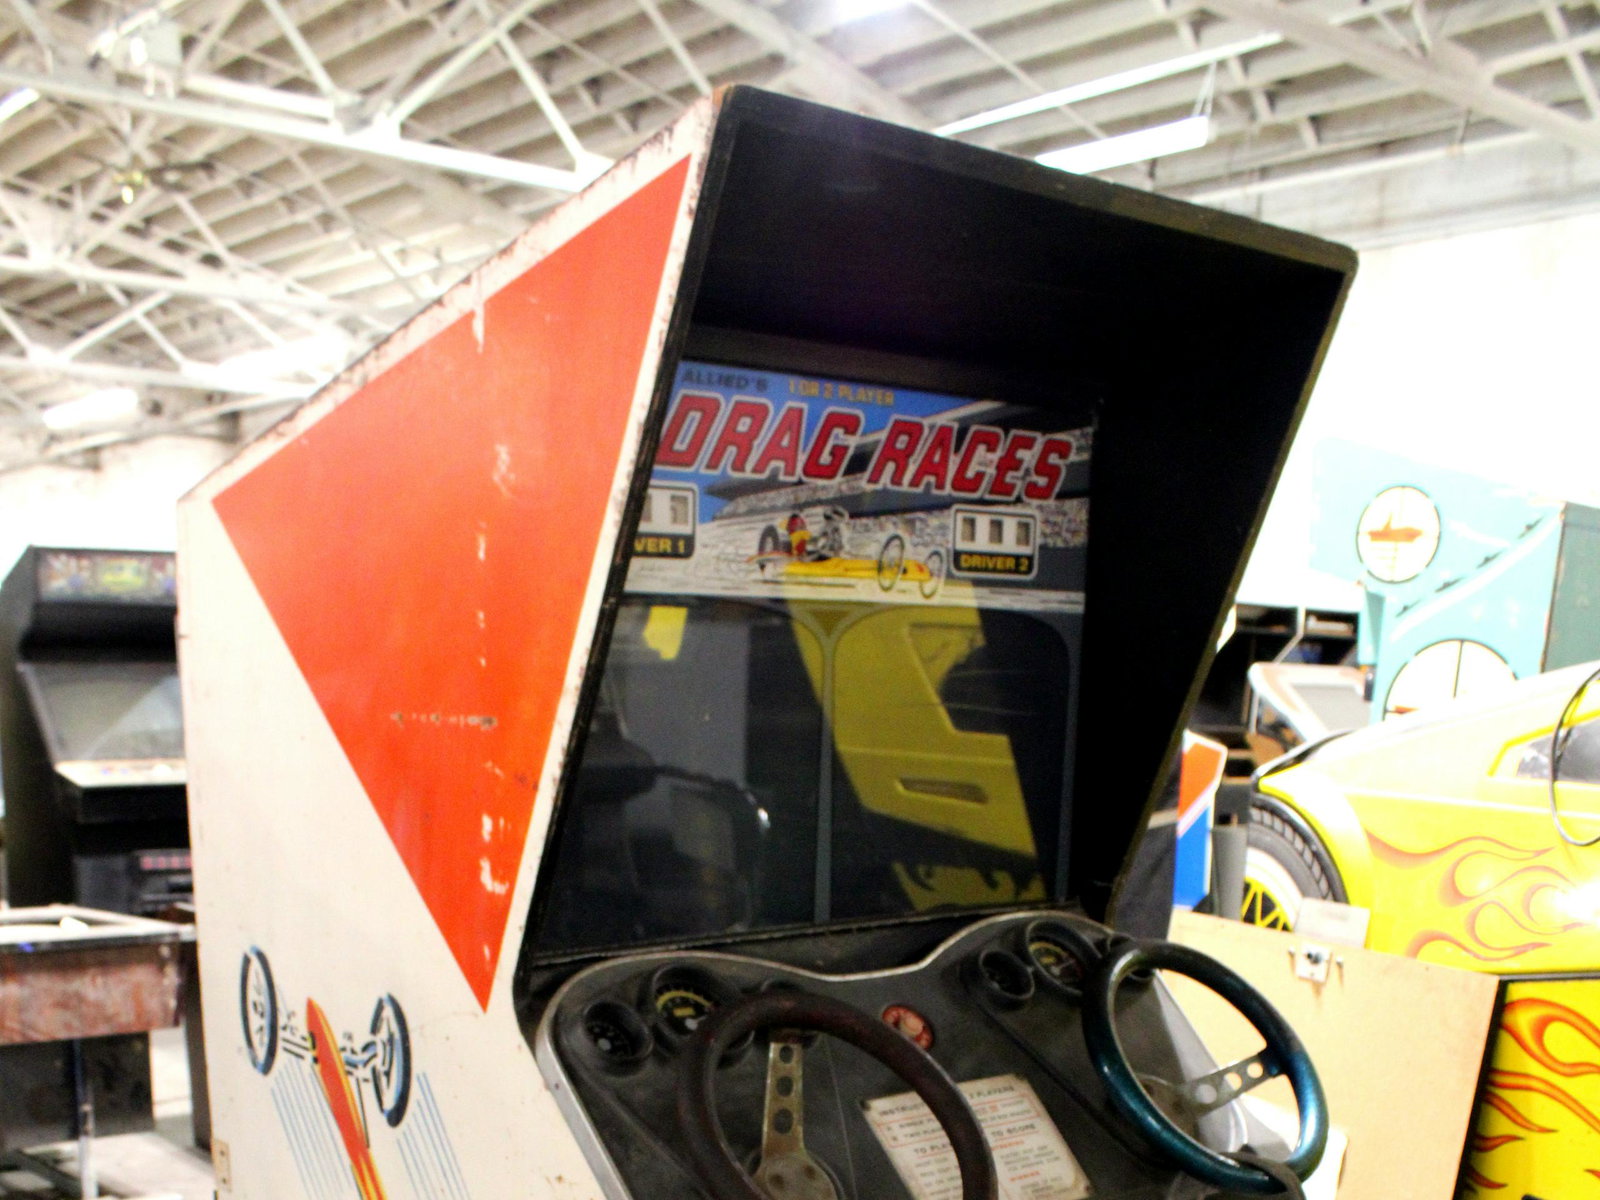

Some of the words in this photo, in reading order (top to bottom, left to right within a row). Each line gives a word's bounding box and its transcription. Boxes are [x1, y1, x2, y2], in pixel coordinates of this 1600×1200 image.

[682, 369, 768, 390] ALLIED'S
[652, 391, 864, 480] DRAG
[865, 415, 1075, 501] RACES
[960, 553, 1016, 571] DRIVER
[1019, 557, 1029, 572] 2
